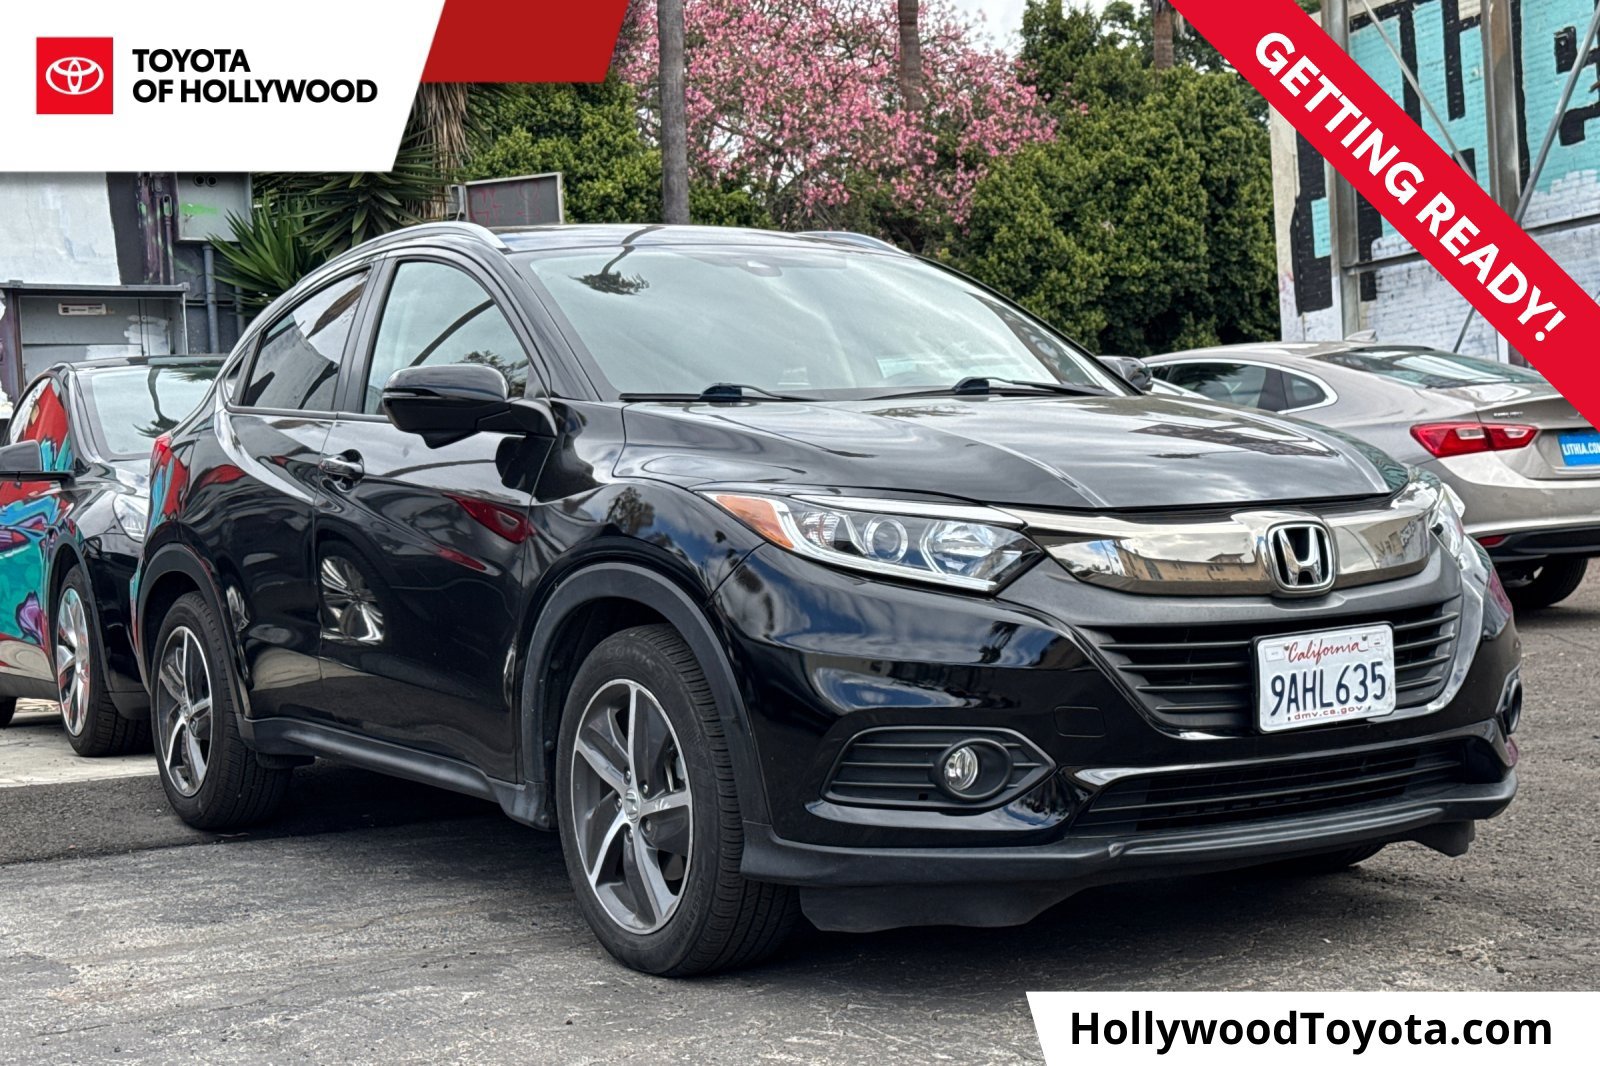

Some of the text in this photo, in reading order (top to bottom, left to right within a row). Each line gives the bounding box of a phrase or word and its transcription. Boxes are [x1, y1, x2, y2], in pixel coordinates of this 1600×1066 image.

[1288, 638, 1368, 665] California
[1270, 661, 1387, 717] 9AHL635
[1294, 706, 1364, 721] dmv.ca.gov
